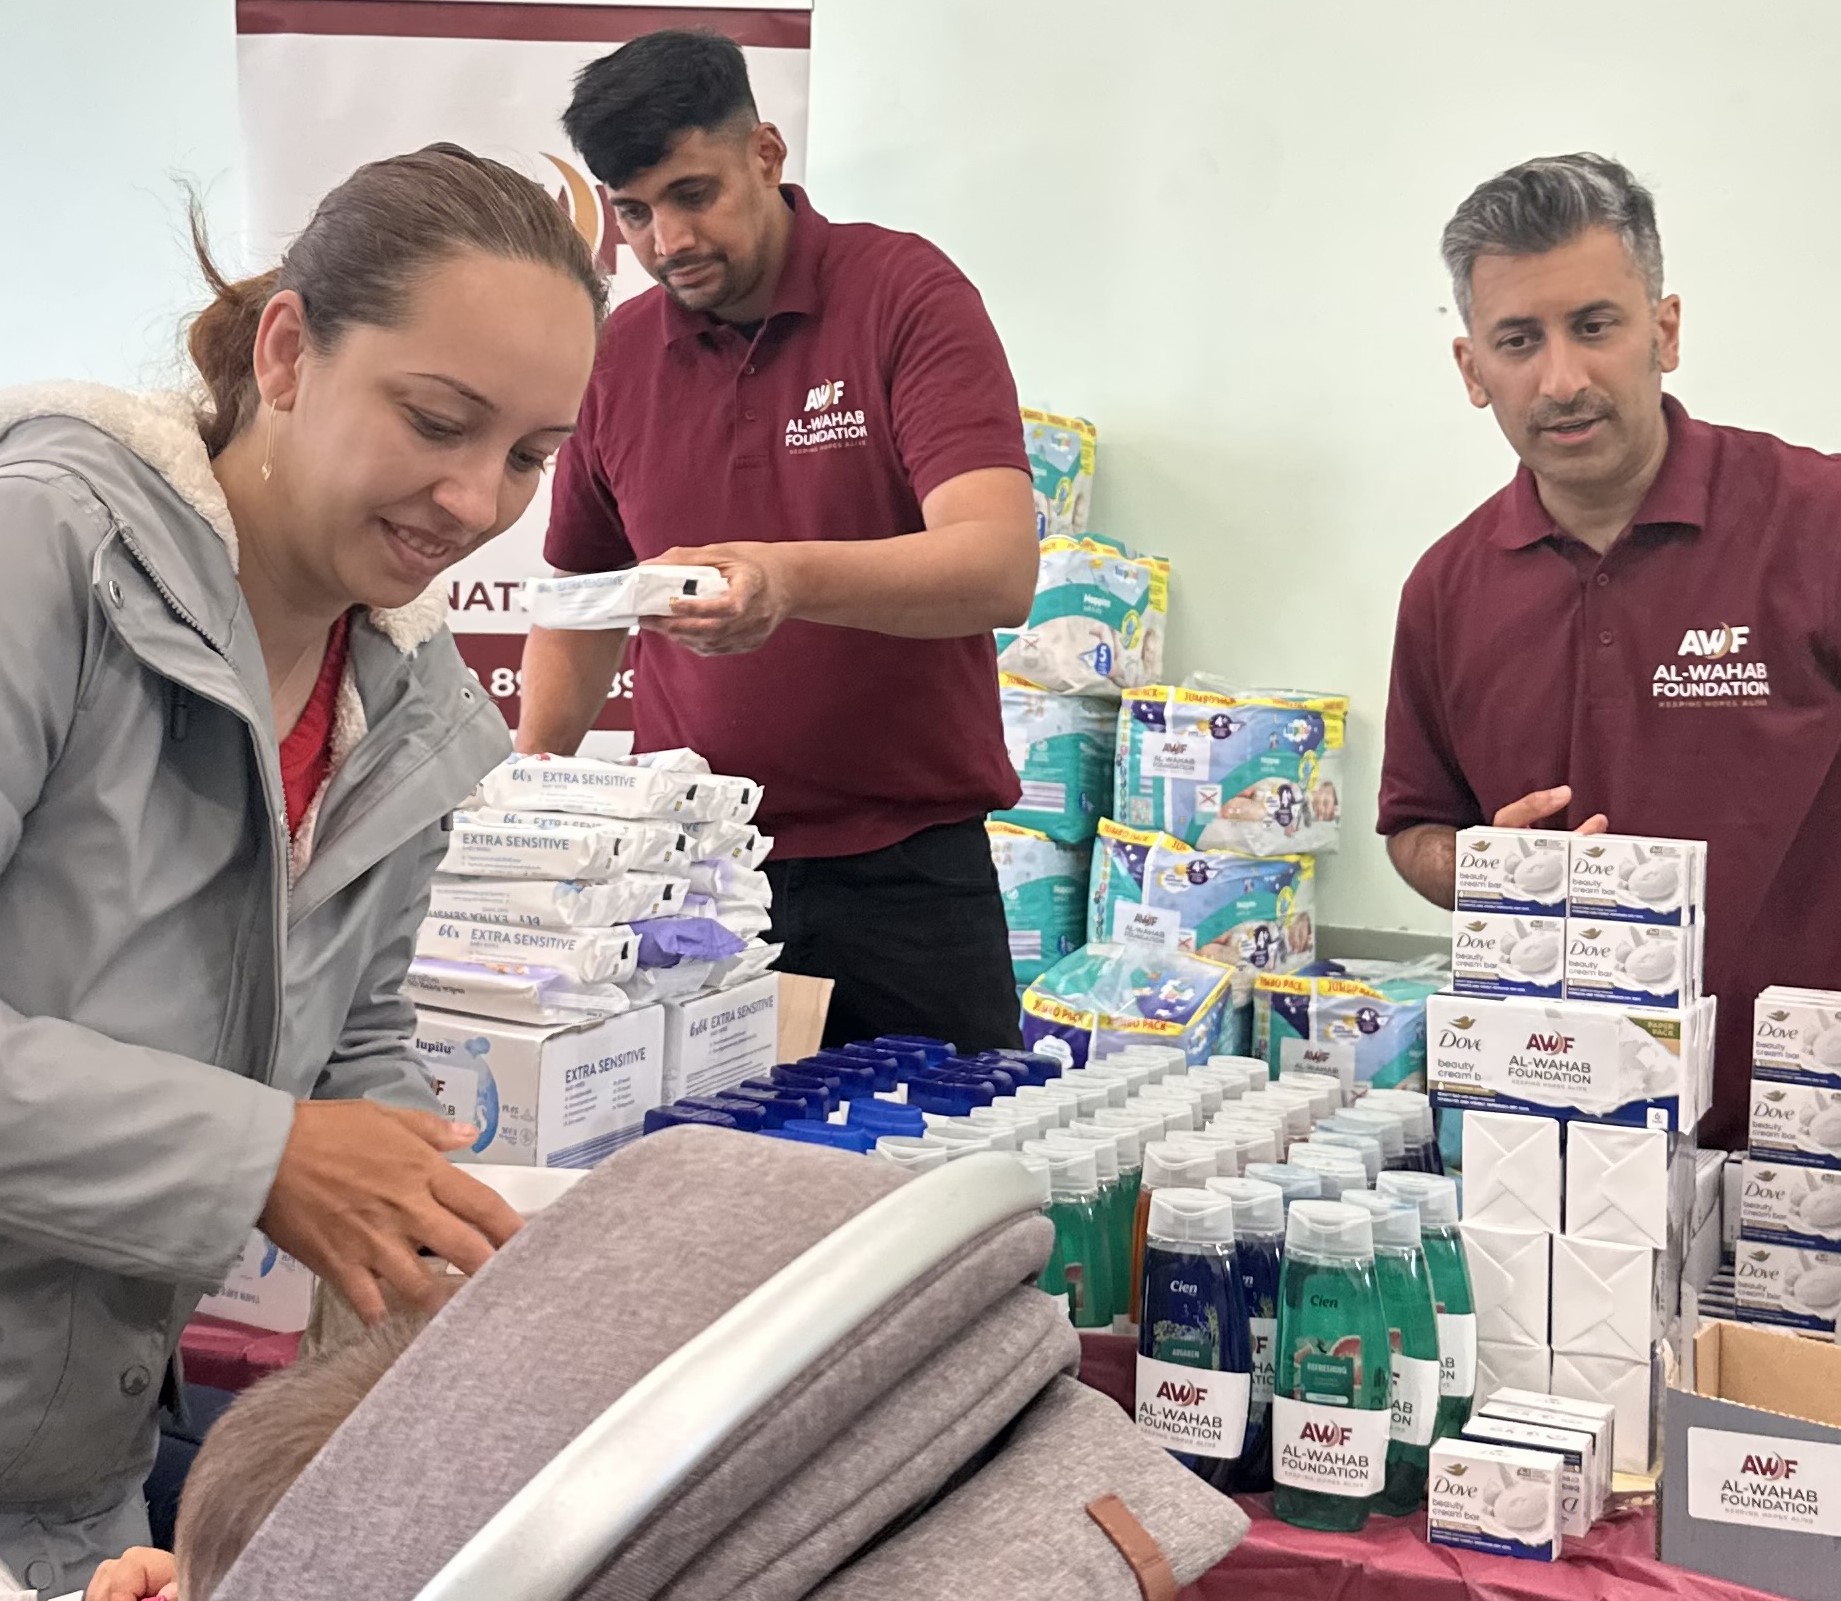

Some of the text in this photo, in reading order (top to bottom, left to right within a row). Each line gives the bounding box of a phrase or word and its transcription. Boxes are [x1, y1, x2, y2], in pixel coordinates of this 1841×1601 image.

[804, 379, 845, 412] AWF
[785, 410, 865, 434] AL-WAHAB
[785, 425, 868, 447] FOUNDATION
[1677, 622, 1750, 659] AWF
[1653, 662, 1768, 681] AL-WAHAB
[1652, 681, 1770, 697] FOUNDATION
[543, 771, 579, 785] EXTRA
[582, 773, 637, 788] SENSITIVE
[462, 833, 503, 846] EXTRA
[506, 836, 569, 850] SENSITIVE
[1460, 851, 1500, 870] Dove
[1573, 857, 1615, 876] Dove
[1459, 872, 1489, 884] beauty
[1459, 880, 1502, 889] cream bar
[471, 928, 511, 944] EXTRA
[514, 933, 576, 951] SENSITIVE
[1456, 932, 1496, 950] Dove
[1569, 939, 1611, 958] Dove
[1455, 952, 1484, 963] beauty
[1456, 960, 1498, 970] cream bar
[1568, 960, 1598, 971] beauty
[1569, 967, 1613, 978] cream bar
[711, 1009, 735, 1029] EXTRA
[737, 994, 774, 1020] SENSITIVE
[1757, 1021, 1799, 1040] Dove
[416, 1038, 452, 1054] lupilu
[1526, 1029, 1575, 1056] AWF
[565, 1047, 647, 1084] EXTRA SENSITIVE
[1438, 1058, 1475, 1072] beauty
[1509, 1055, 1591, 1073] AL-WAHAB
[1437, 1069, 1472, 1080] cream
[1508, 1067, 1591, 1084] FOUNDATION
[1753, 1101, 1795, 1120] Dove
[1744, 1181, 1785, 1201] Dove
[1738, 1261, 1779, 1281] Dove
[1170, 1279, 1198, 1295] Cien
[1310, 1294, 1339, 1309] Cien
[1156, 1379, 1208, 1407] AWF
[1139, 1401, 1223, 1429] AL-WAHAB
[1138, 1413, 1222, 1441] FOUNDATION
[1300, 1420, 1353, 1448] AWF
[1282, 1444, 1369, 1468] AL-WAHAB
[1281, 1457, 1369, 1480] FOUNDATION
[1741, 1451, 1798, 1481] AWF
[1432, 1475, 1478, 1499] Dove
[1721, 1479, 1818, 1503] AL-WAHAB
[1432, 1497, 1464, 1512] beauty
[1720, 1493, 1819, 1516] FOUNDATION
[1432, 1508, 1480, 1521] cream bar
